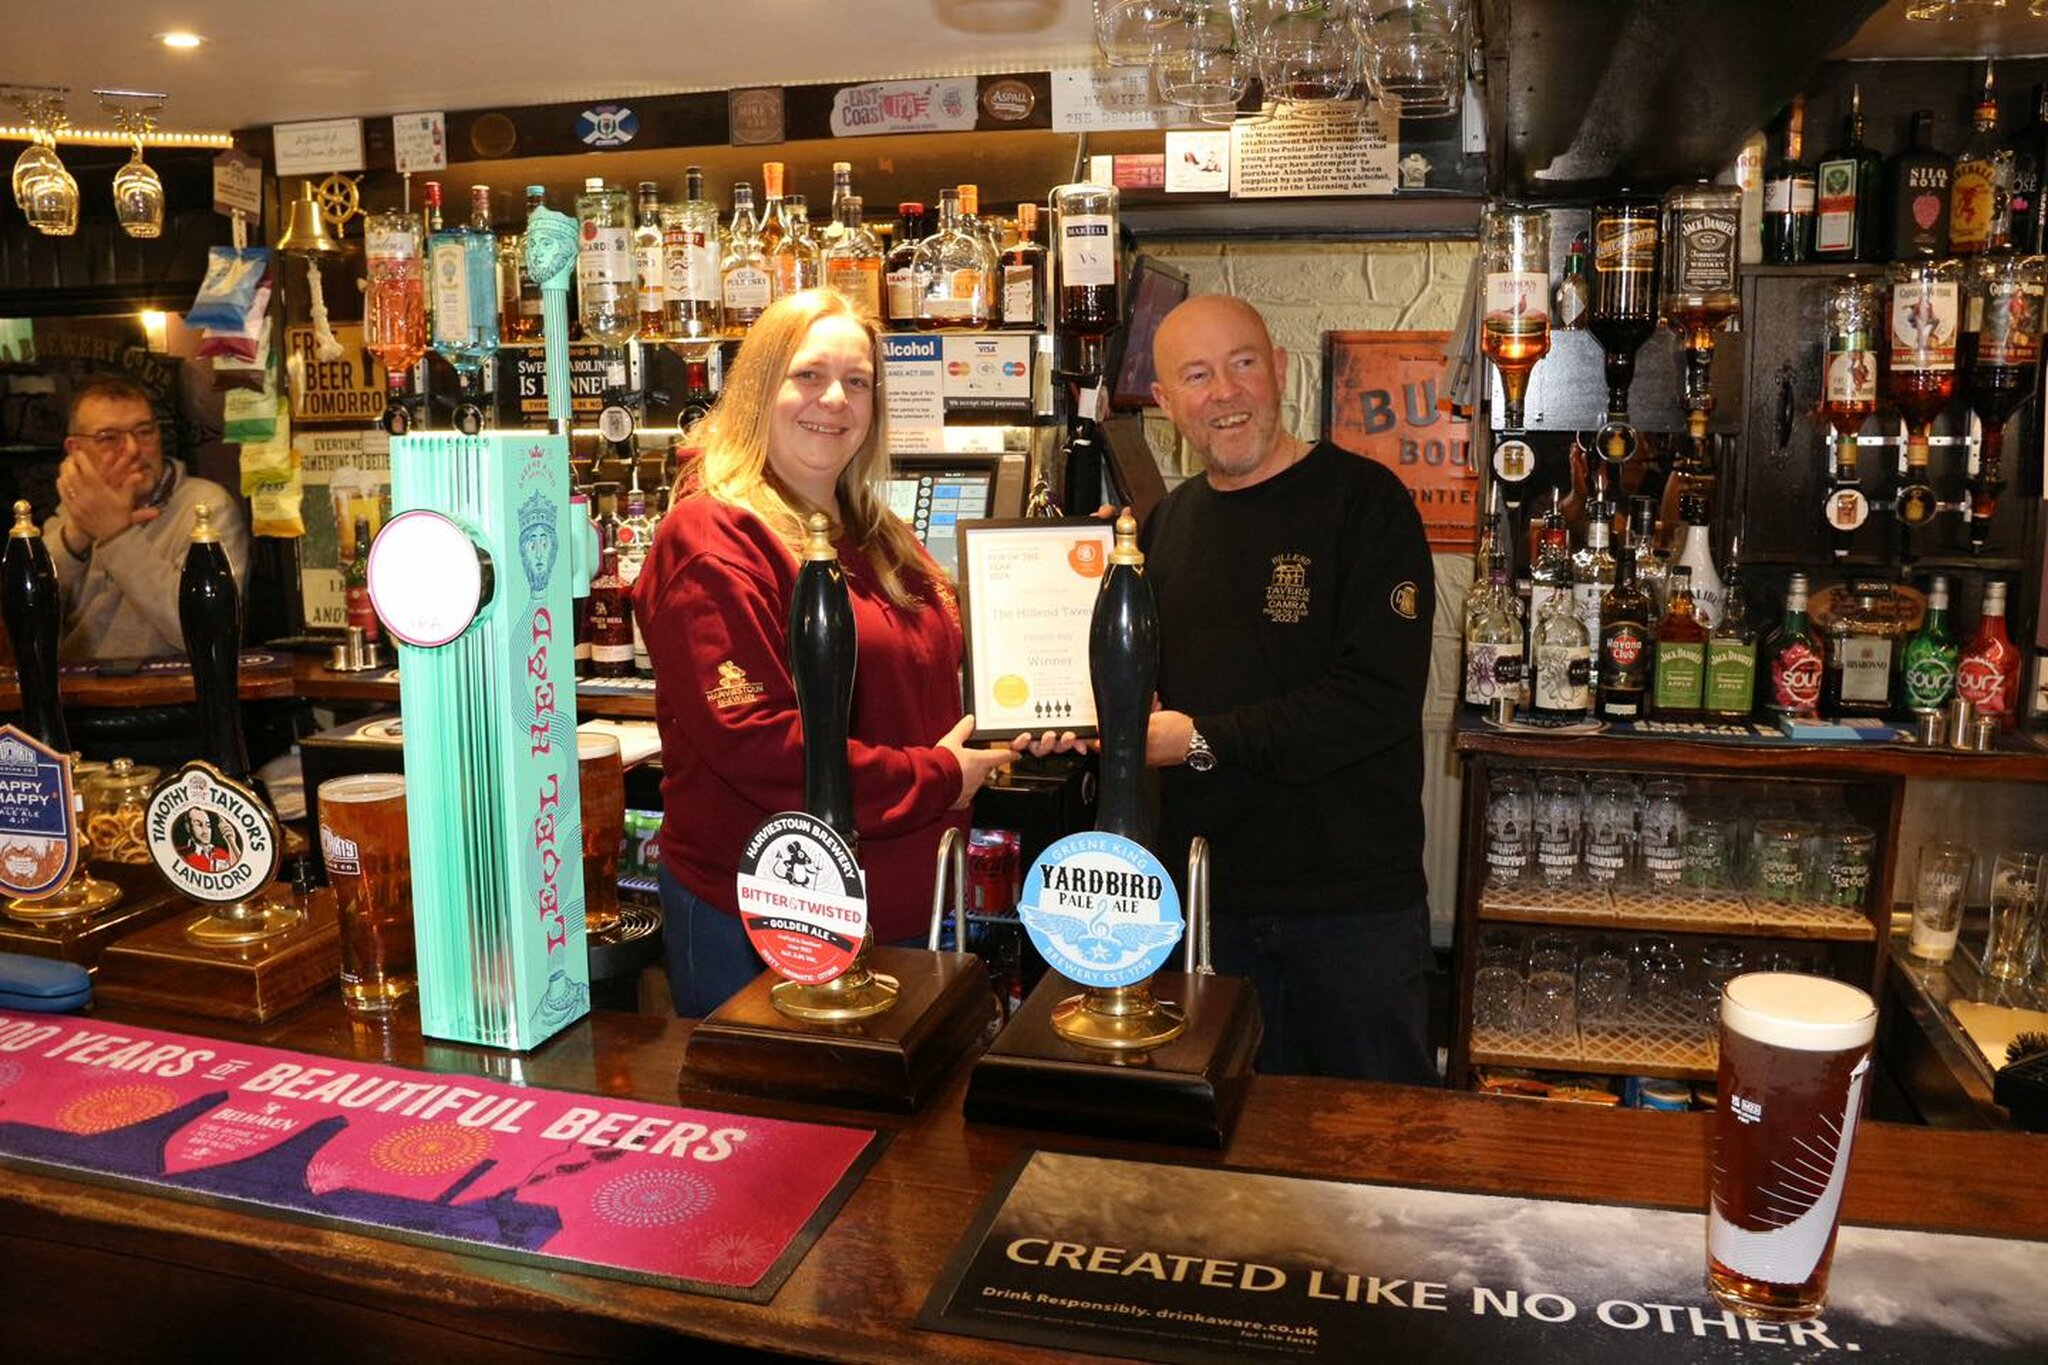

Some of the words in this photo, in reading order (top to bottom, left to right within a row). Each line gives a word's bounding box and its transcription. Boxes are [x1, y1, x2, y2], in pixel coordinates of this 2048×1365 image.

[849, 88, 879, 106] EAST
[1241, 138, 1300, 146] establishment
[1256, 130, 1308, 138] Management
[1268, 154, 1302, 163] persons
[1329, 151, 1368, 159] eighteen
[1311, 159, 1357, 167] attempted
[1241, 170, 1280, 178] purchase
[1241, 177, 1279, 185] supplied
[1306, 182, 1349, 190] Licensing
[978, 346, 996, 354] VISA
[305, 360, 354, 391] BEER
[520, 375, 536, 396] IS
[1265, 586, 1310, 596] TAVERN
[1268, 600, 1307, 610] CAMRA
[1606, 639, 1642, 649] Havana
[1027, 654, 1073, 667] Winner
[1612, 649, 1636, 660] Club
[527, 606, 556, 759] HEAD
[1618, 671, 1627, 683] 7
[21, 811, 40, 819] ALE
[153, 786, 190, 844] TIMOTHY
[208, 787, 266, 853] TAYLOR'S
[746, 817, 811, 861] HARVIESTOUN
[810, 825, 857, 880] BREWERY
[1051, 839, 1108, 861] GREENE
[1112, 844, 1148, 870] KING
[535, 773, 567, 956] LEVEL
[171, 858, 253, 891] LANDLORD
[1039, 863, 1163, 901] YARDBIRD
[1058, 892, 1095, 910] PALE
[1111, 900, 1139, 914] ALE
[769, 919, 810, 935] GOLDEN
[811, 926, 831, 942] ALE
[1043, 945, 1099, 981] BREWERY
[1103, 973, 1126, 983] EST
[1129, 957, 1153, 977] 1799
[43, 1032, 217, 1079] YEARS
[212, 1060, 250, 1080] OF
[239, 1062, 536, 1134] BEAUTIFUL
[540, 1106, 749, 1163] BEERS
[210, 1107, 300, 1132] BELHAVEN
[1006, 1237, 1288, 1293] CREATED
[1307, 1269, 1448, 1313] LIKE
[1472, 1286, 1578, 1324] NO
[1595, 1299, 1862, 1351] OTHER.
[982, 1286, 1032, 1302] Drink
[1036, 1292, 1152, 1318] Responsibly.
[1155, 1308, 1320, 1338] drinkaware.co.uk
[1240, 1330, 1259, 1340] for
[1262, 1331, 1284, 1342] the
[1286, 1334, 1319, 1347] facts
